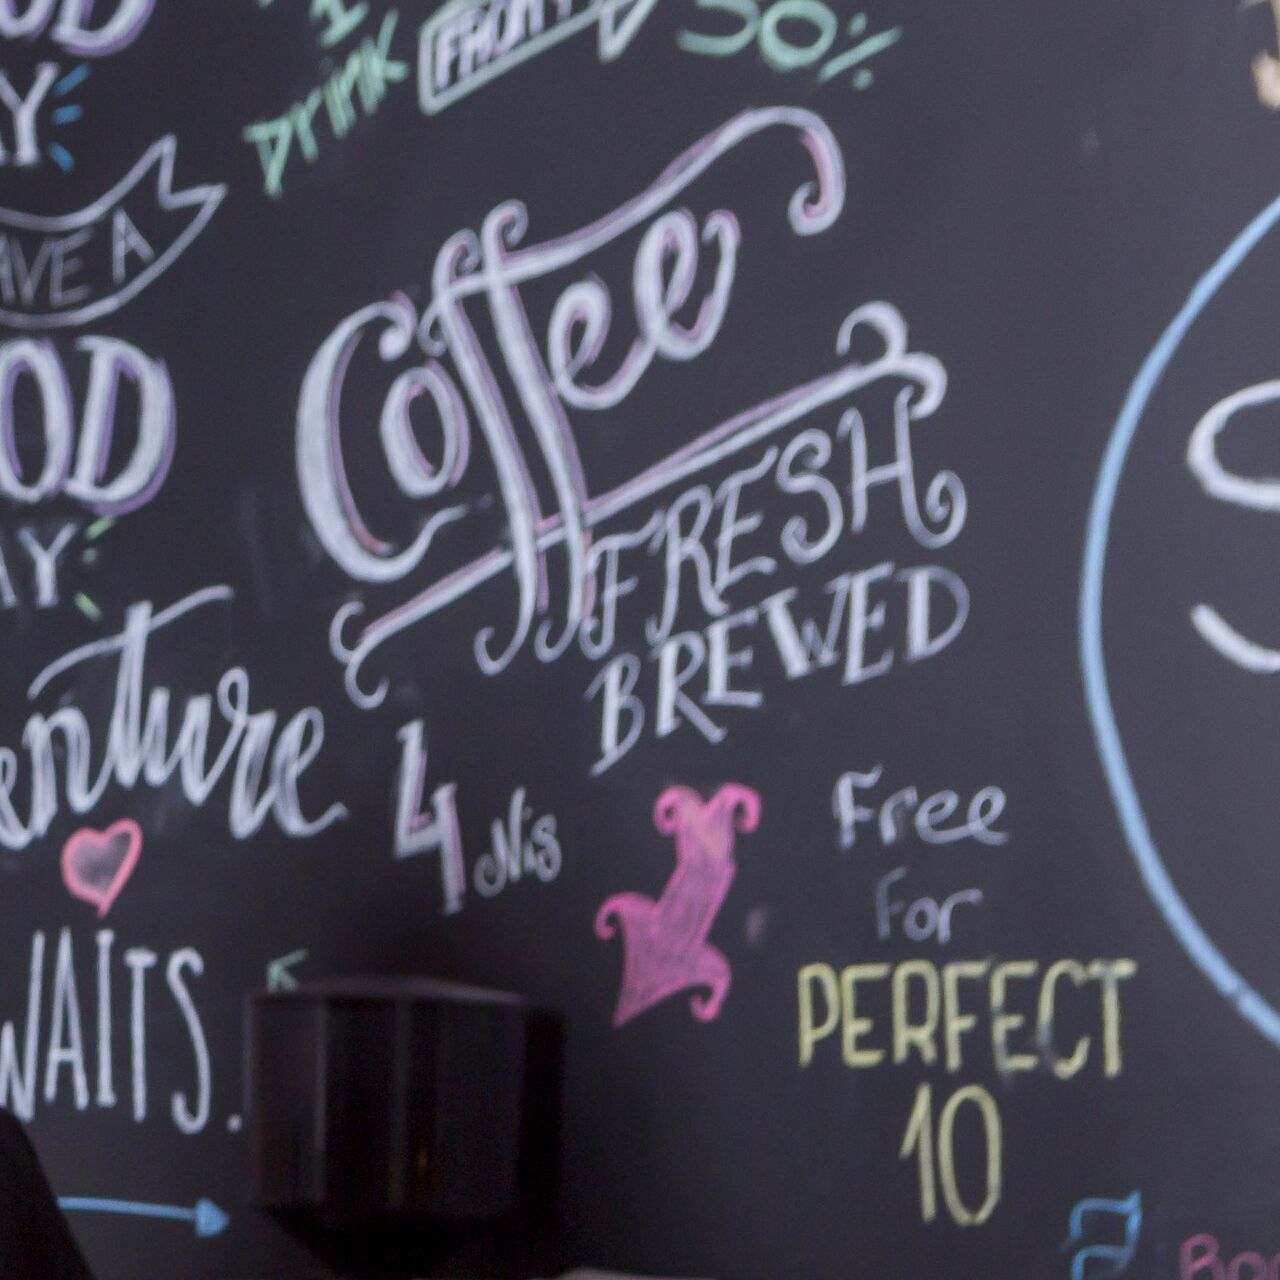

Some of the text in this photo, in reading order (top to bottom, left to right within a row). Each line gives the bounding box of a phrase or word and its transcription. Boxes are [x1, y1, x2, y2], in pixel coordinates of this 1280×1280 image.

[111, 206, 156, 285] A
[295, 105, 845, 675] Coffee
[580, 385, 968, 662] FRESH
[584, 560, 971, 778] BREWED
[393, 718, 466, 916] 4
[832, 763, 1011, 851] Free
[874, 865, 984, 945] For
[796, 955, 1138, 1082] PERFECT
[898, 1081, 1003, 1228] 10
